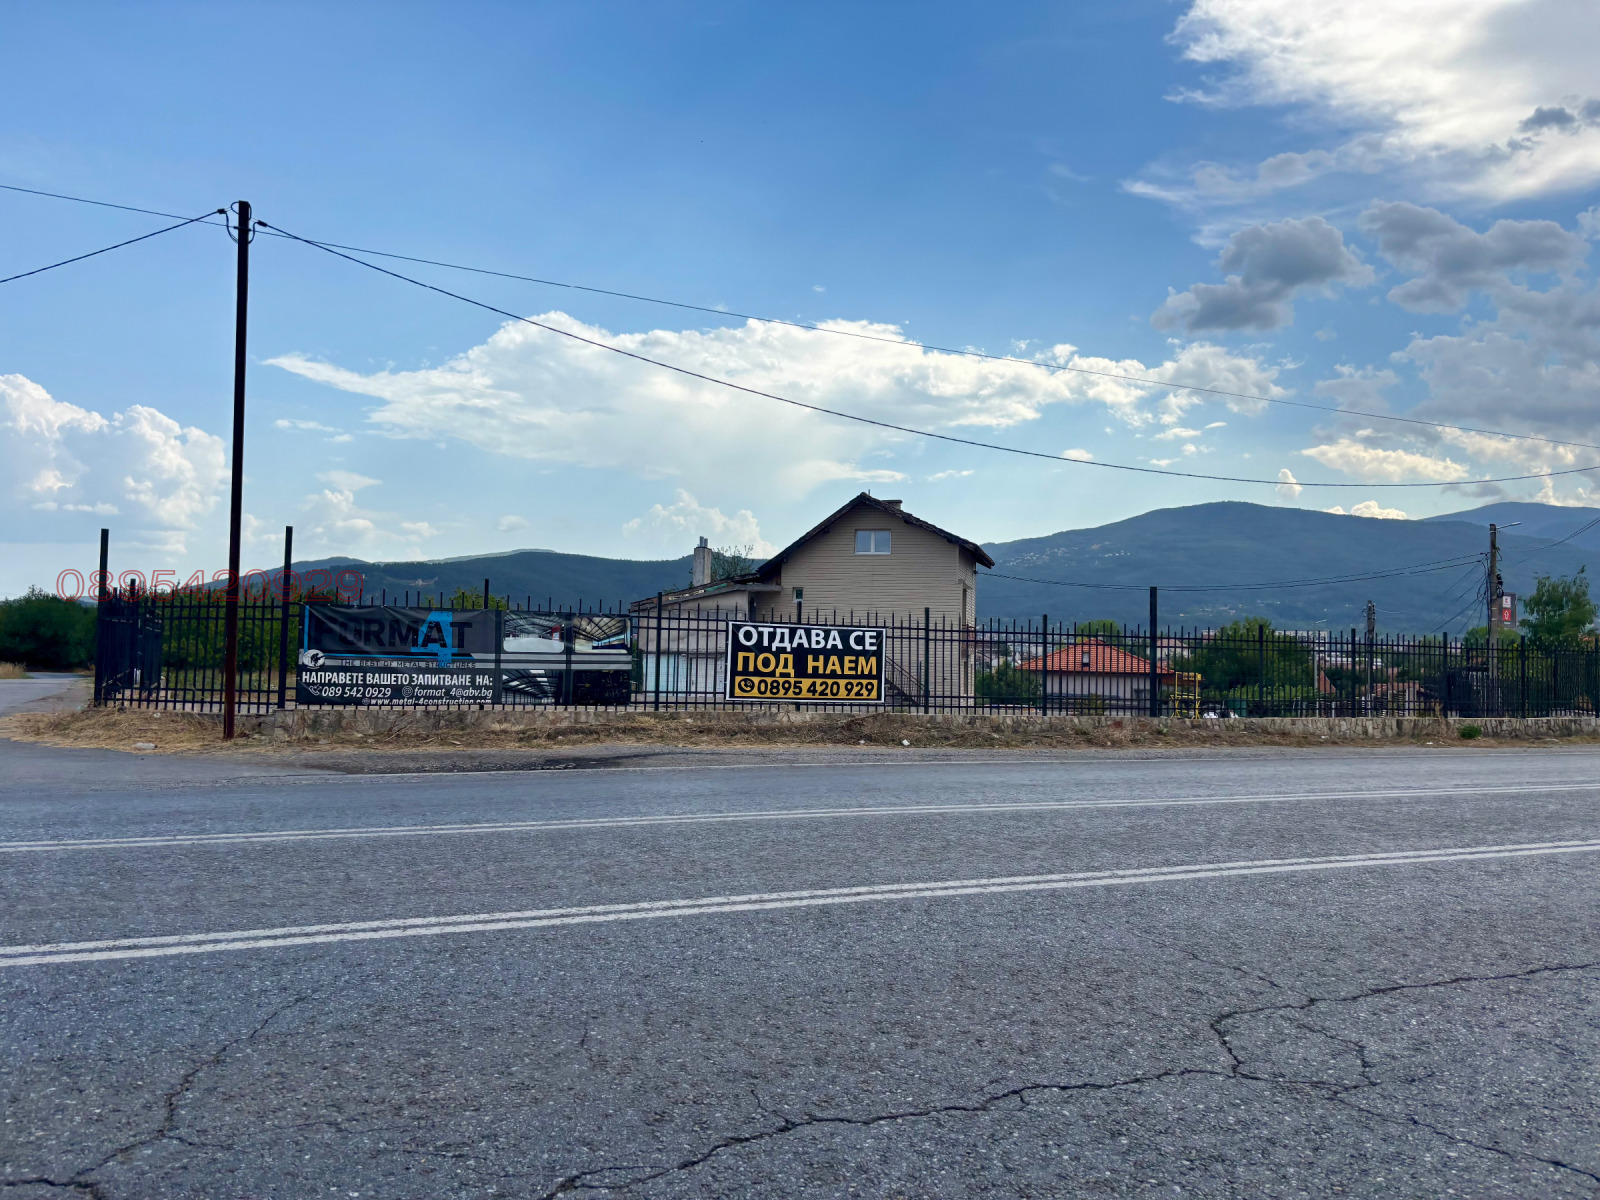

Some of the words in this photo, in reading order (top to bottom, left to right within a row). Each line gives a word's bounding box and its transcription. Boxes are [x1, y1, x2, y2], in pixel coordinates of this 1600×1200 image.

[738, 626, 843, 652] ОТДАВА
[849, 631, 878, 651] СЕ
[737, 651, 795, 678] ПОД
[807, 655, 877, 675] НАЕМ
[302, 671, 364, 684] НАПРАВЕТЕ
[366, 673, 410, 685] ВАШЕТО
[411, 674, 472, 686] ЗАПИТВАНЕ
[476, 675, 493, 686] НА:
[322, 686, 342, 697] 089
[343, 687, 364, 698] 542
[365, 687, 391, 698] 0929
[413, 686, 493, 699] format_4@abv.bg
[757, 679, 803, 696] 0895
[806, 680, 840, 697] 420
[844, 681, 875, 697] 929
